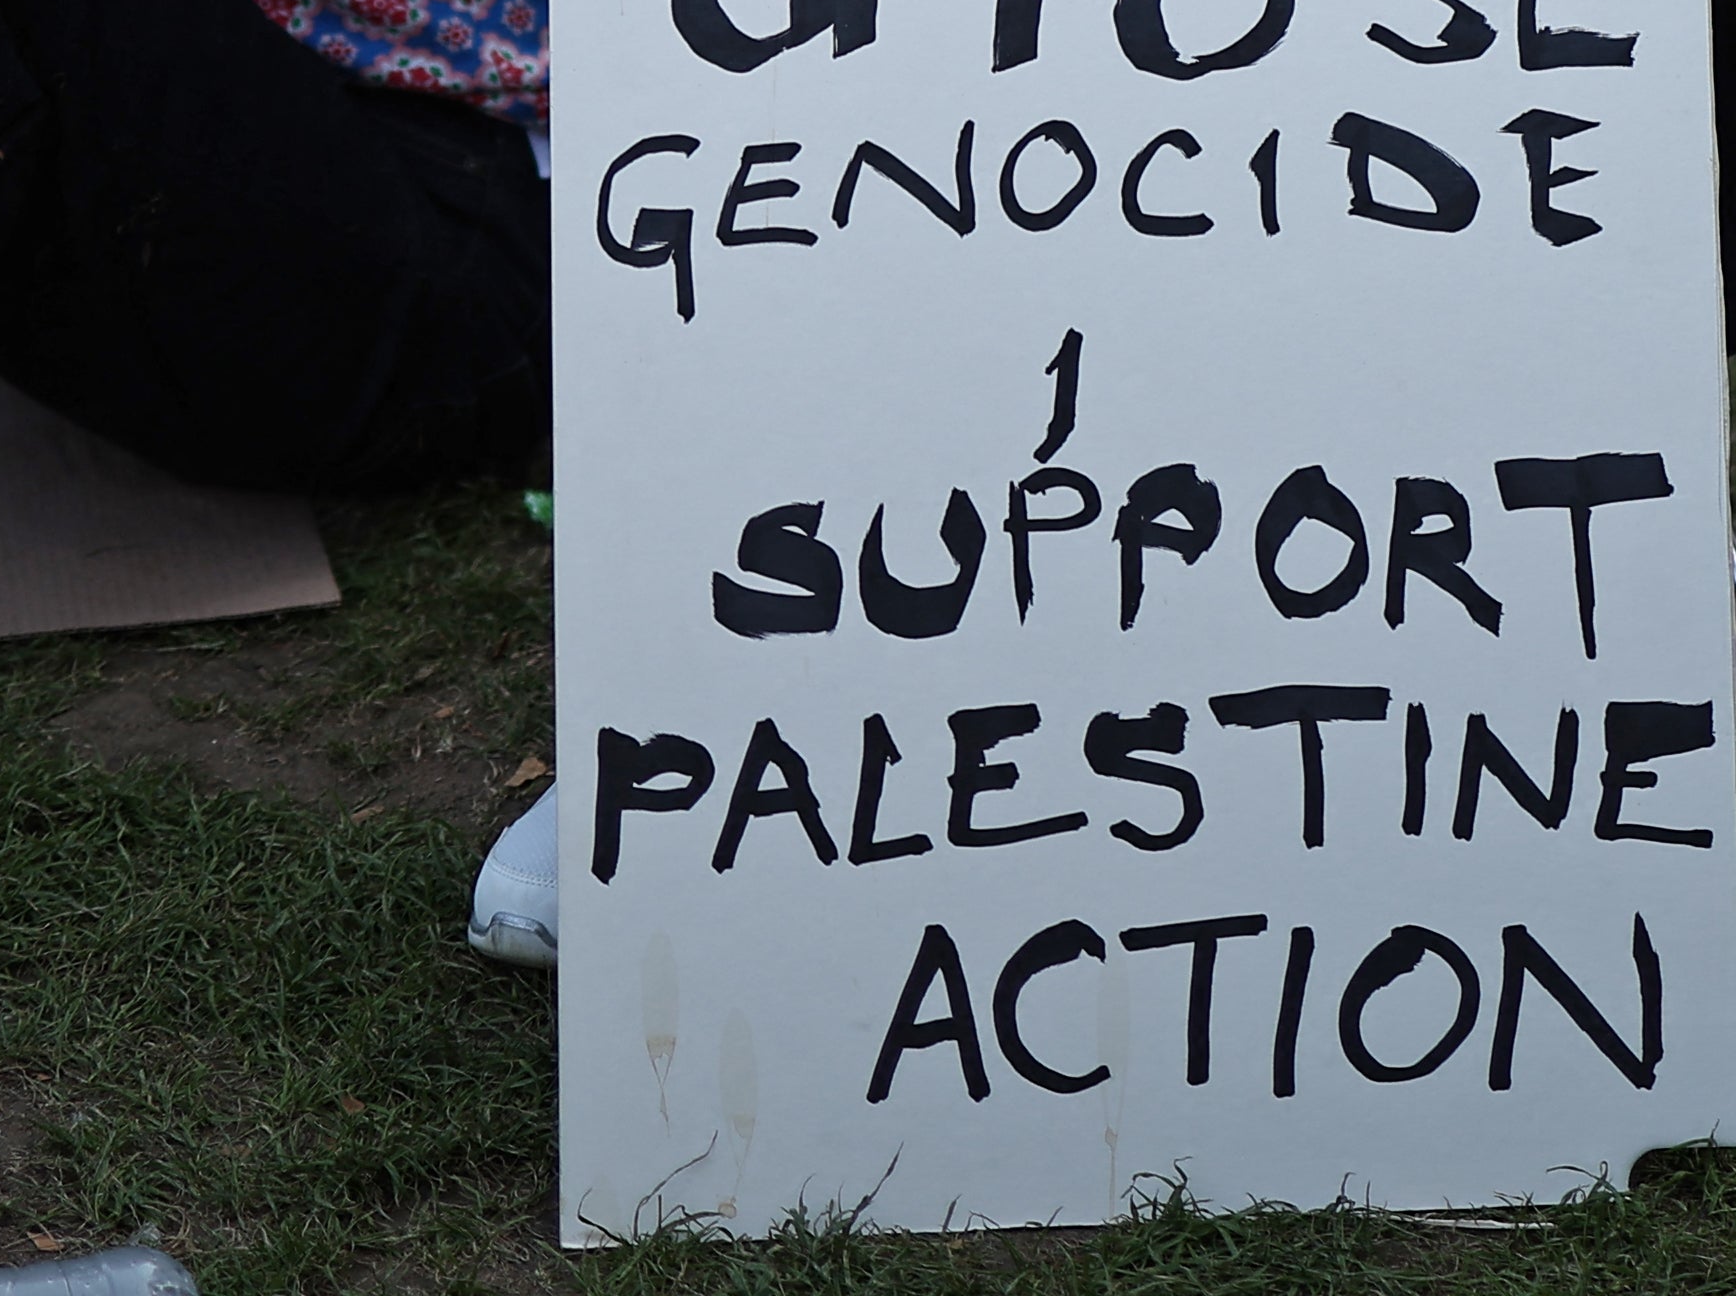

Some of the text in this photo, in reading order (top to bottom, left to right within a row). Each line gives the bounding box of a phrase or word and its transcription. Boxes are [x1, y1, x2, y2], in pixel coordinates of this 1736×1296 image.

[597, 109, 1602, 323] GENOCIDE
[712, 452, 1674, 659] SUPPORT
[592, 685, 1715, 885] PALESTINE
[867, 912, 1664, 1104] ACTION
